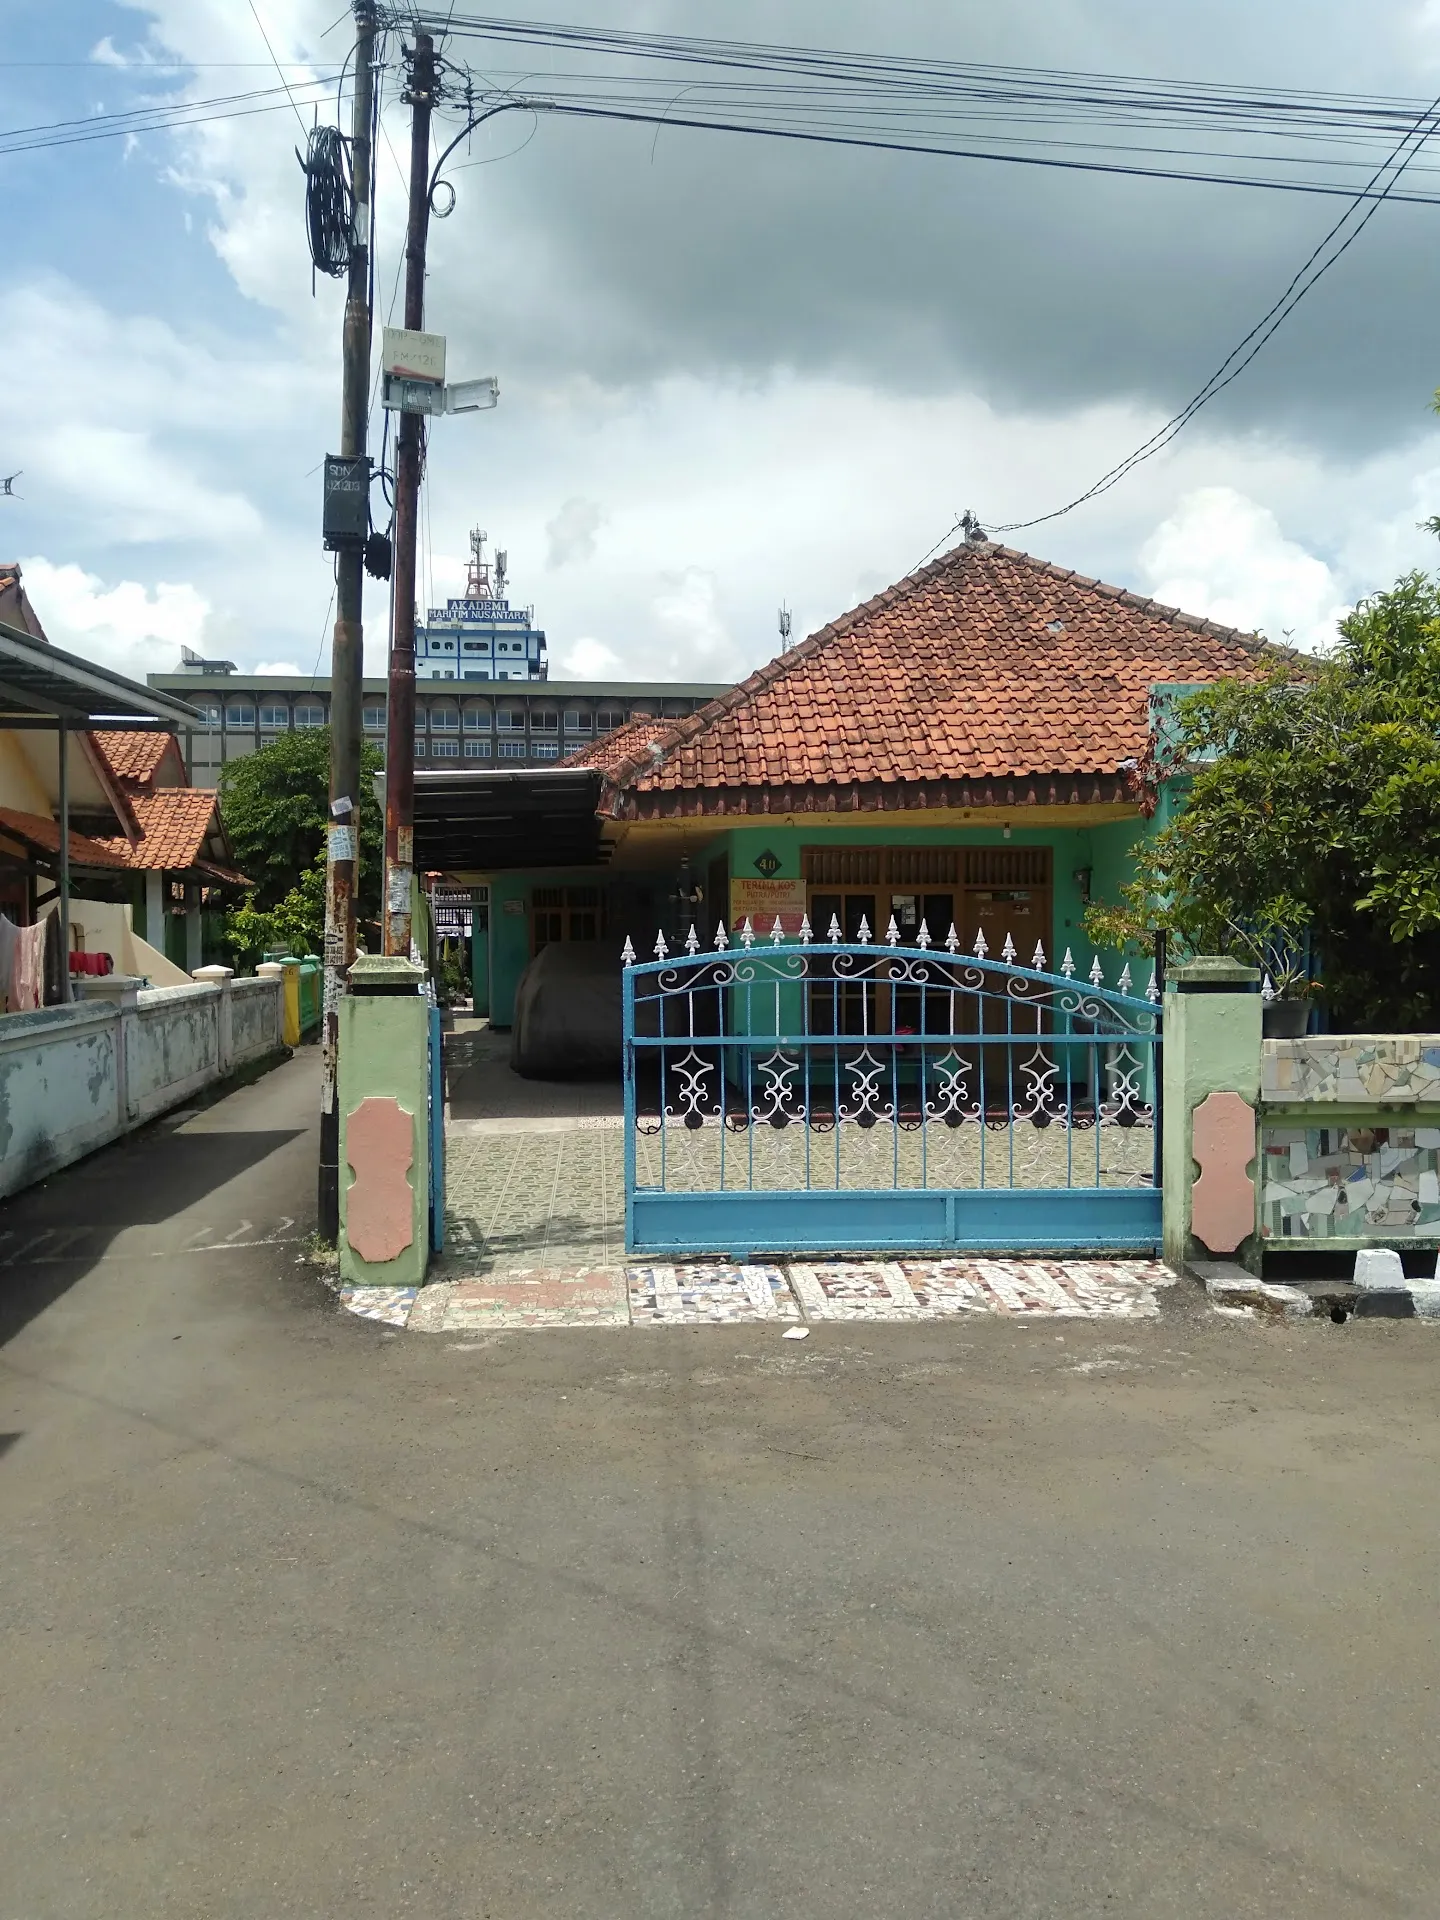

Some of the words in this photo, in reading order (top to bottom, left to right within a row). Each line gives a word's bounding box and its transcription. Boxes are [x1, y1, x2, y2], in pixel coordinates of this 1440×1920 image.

[450, 600, 507, 611] AKADEMI
[428, 609, 469, 619] MARITIM
[471, 610, 528, 620] NUSANTARA
[741, 881, 775, 890] TERIMA
[777, 882, 796, 890] KOS
